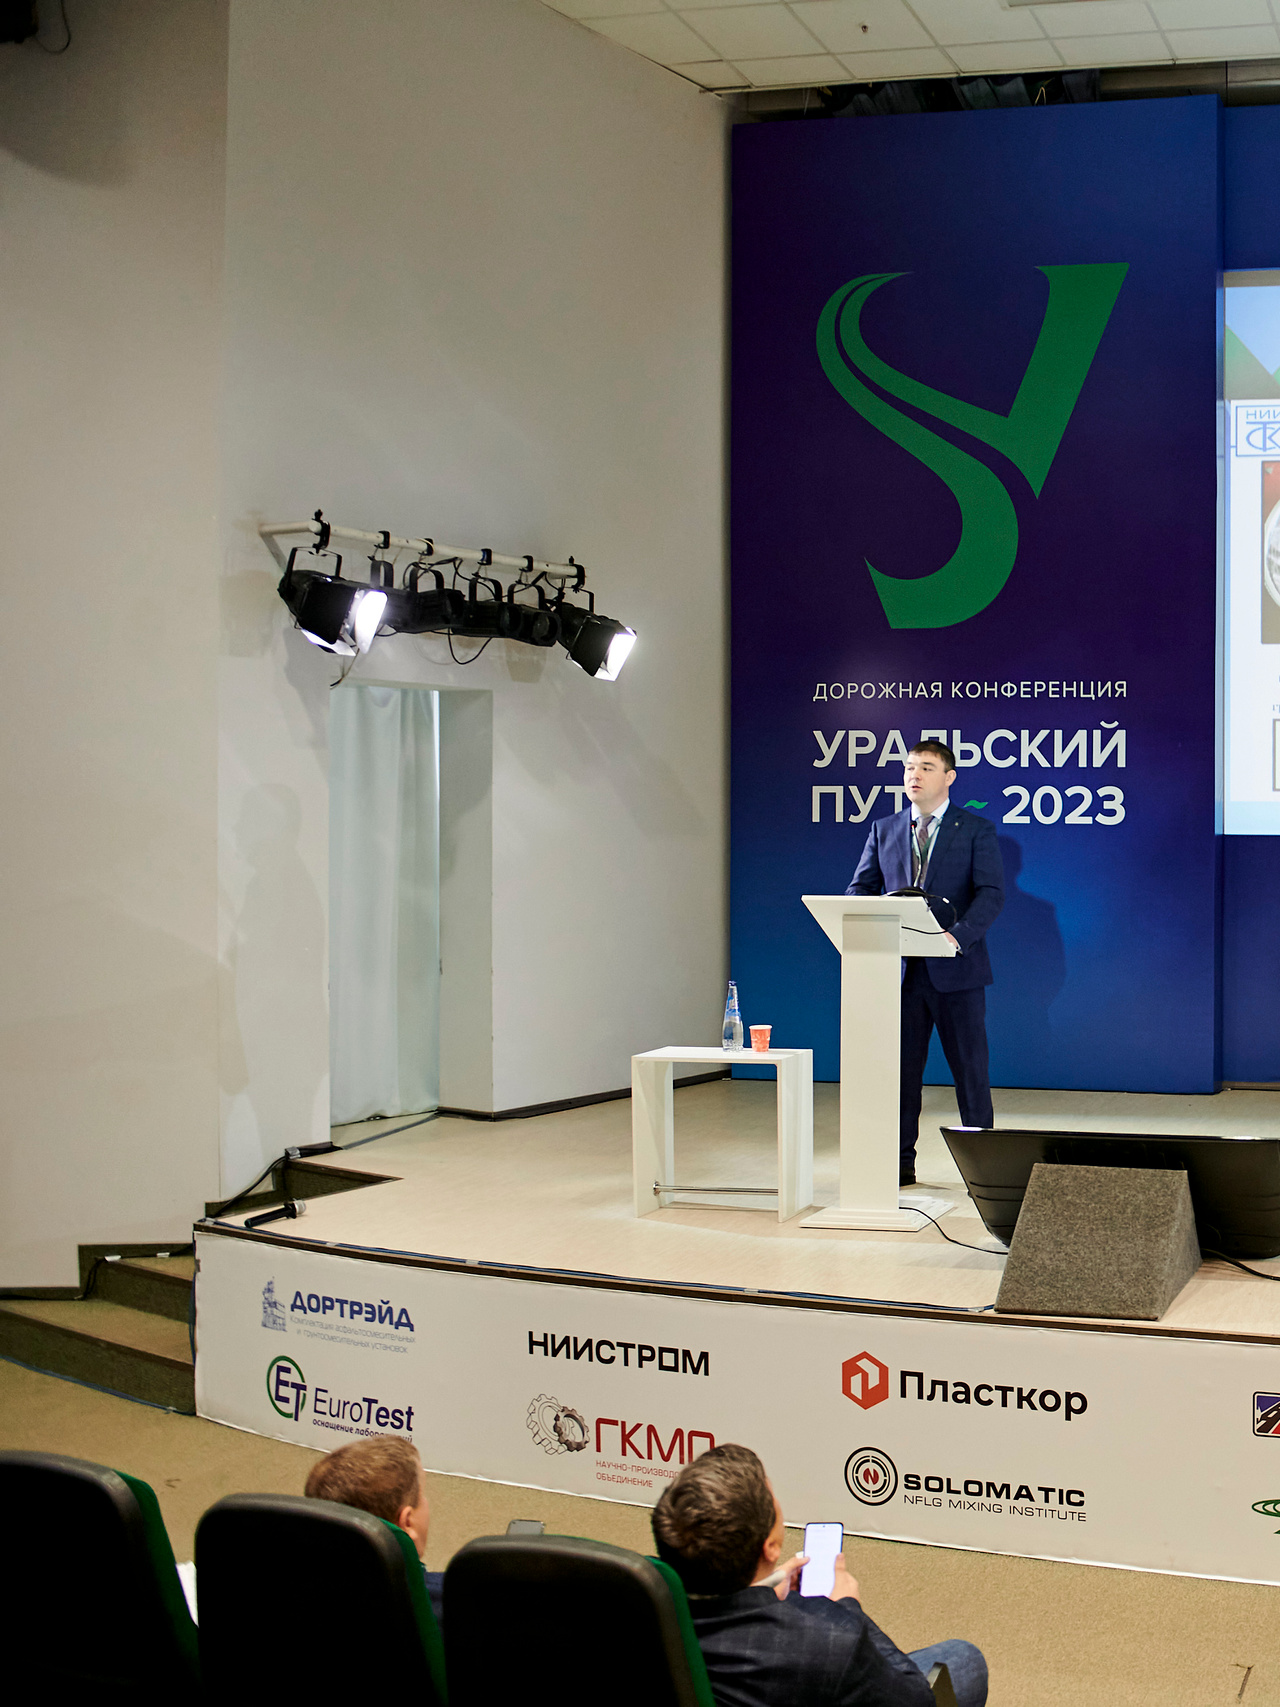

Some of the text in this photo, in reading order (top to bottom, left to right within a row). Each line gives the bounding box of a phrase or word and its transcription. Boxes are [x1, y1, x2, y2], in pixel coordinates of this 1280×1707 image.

[812, 680, 1128, 702] ДОРОЖНАЯ КОНФЕРЕНЦИЯ
[811, 785, 1126, 826] ПУТ 2023
[290, 1290, 415, 1332] ДОРТРЭЙД
[528, 1330, 710, 1376] НИИСТРОМ
[313, 1387, 415, 1432] EuroTest
[900, 1370, 1088, 1422] Пласткор
[312, 1418, 354, 1434] оснащение
[596, 1472, 653, 1488] ОБЪЕДИНЕНИЕ
[904, 1473, 1086, 1508] SOLOMATIC
[904, 1494, 1087, 1522] NFLG MIXING INSTITUTE
